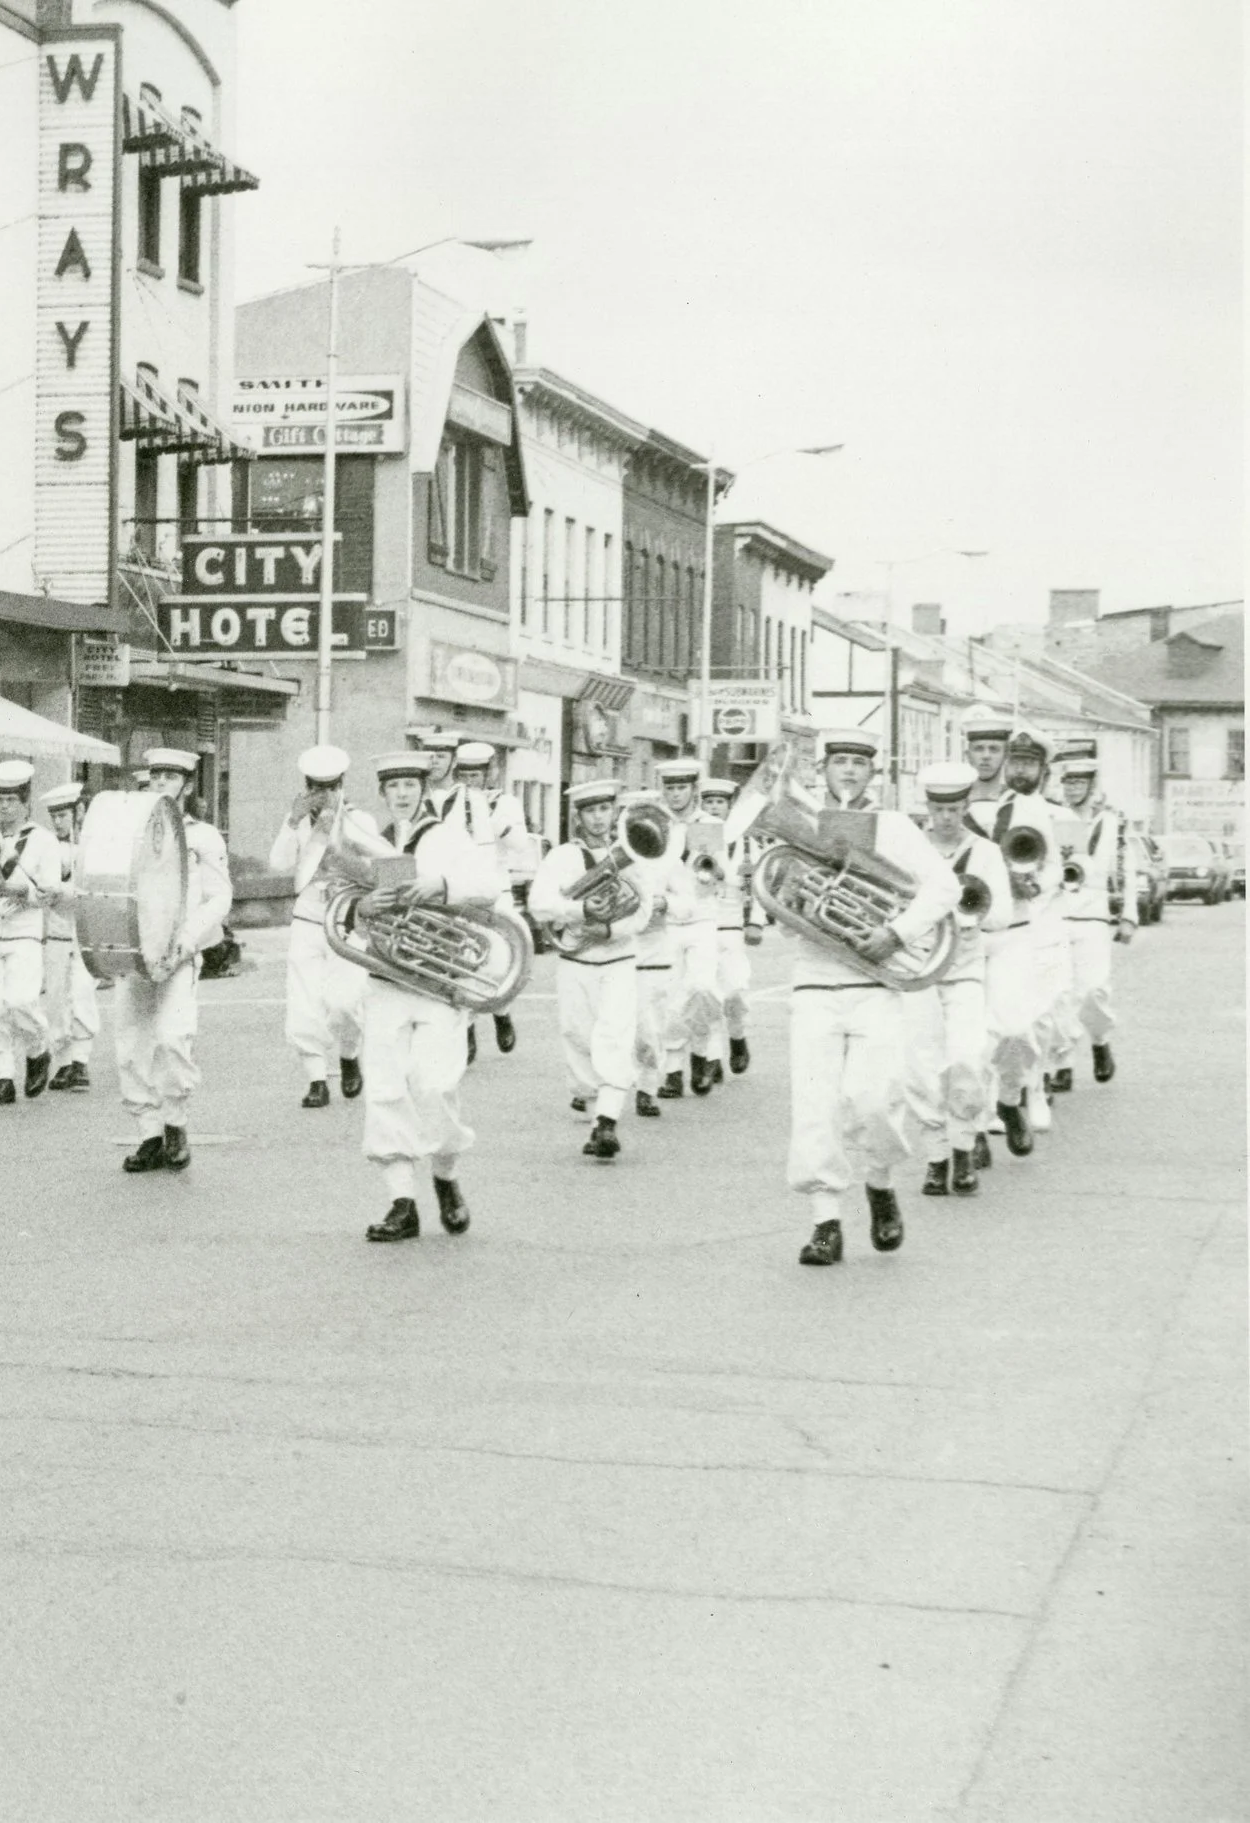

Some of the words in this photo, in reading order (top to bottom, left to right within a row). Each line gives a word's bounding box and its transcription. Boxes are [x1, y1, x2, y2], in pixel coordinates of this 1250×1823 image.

[46, 53, 104, 462] WRAYS
[232, 403, 275, 413] NION
[268, 427, 306, 446] Gift
[312, 426, 378, 446] Cttage
[195, 543, 323, 586] CITY
